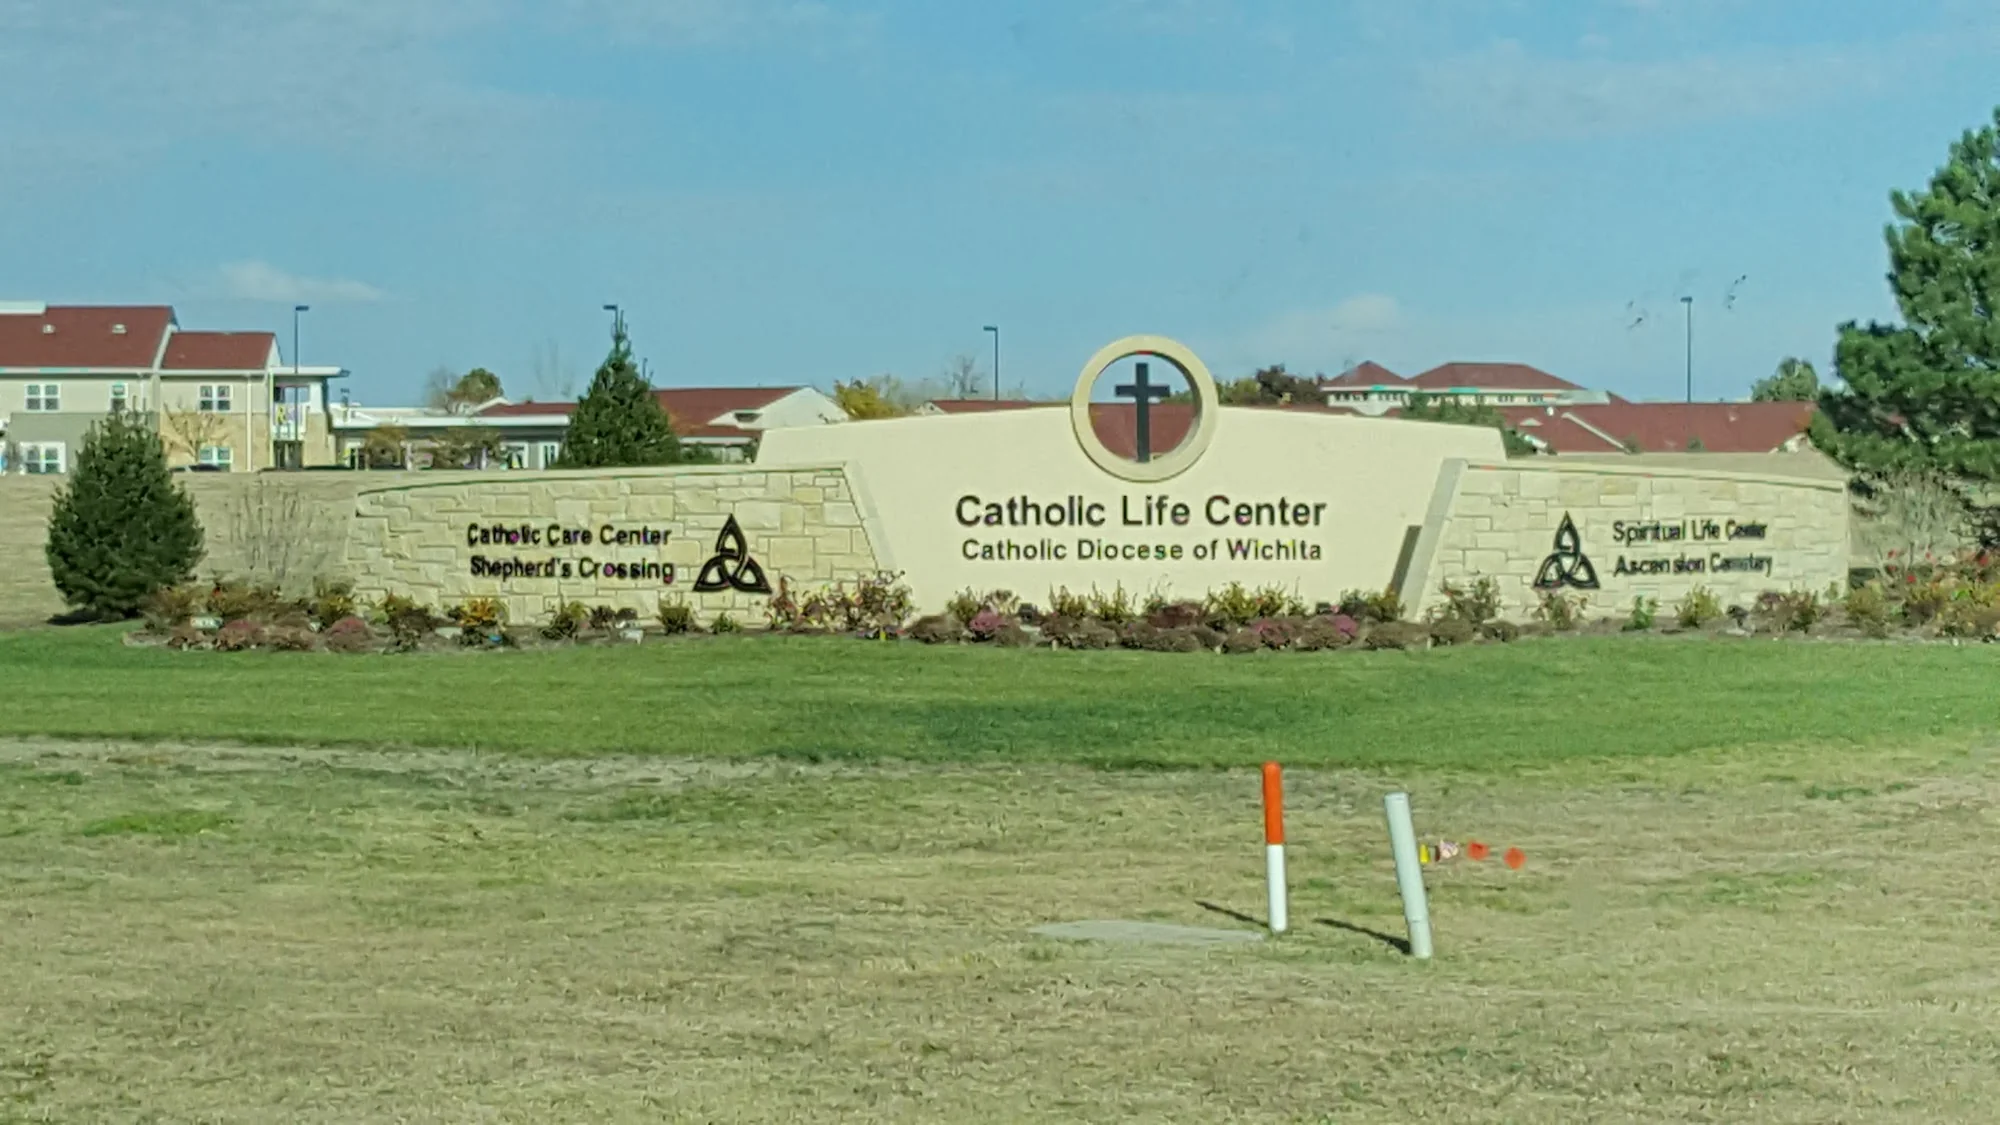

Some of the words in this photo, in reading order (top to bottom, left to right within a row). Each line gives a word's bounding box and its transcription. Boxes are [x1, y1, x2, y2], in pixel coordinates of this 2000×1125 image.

[955, 495, 1106, 526] Catholic
[1122, 495, 1191, 526] Life
[1205, 495, 1327, 526] Center
[467, 523, 541, 546] Catholic
[546, 524, 592, 546] Care
[600, 524, 672, 545] Center
[1613, 520, 1686, 547] Spiritual
[1692, 519, 1720, 541] Life
[961, 539, 1067, 560] Catholic
[1077, 539, 1183, 560] Diocese
[1192, 539, 1218, 560] of
[1226, 538, 1322, 560] Wichita
[470, 555, 572, 582] Shepherd's
[579, 557, 675, 584] Crossing
[1710, 552, 1772, 577] Cetey
